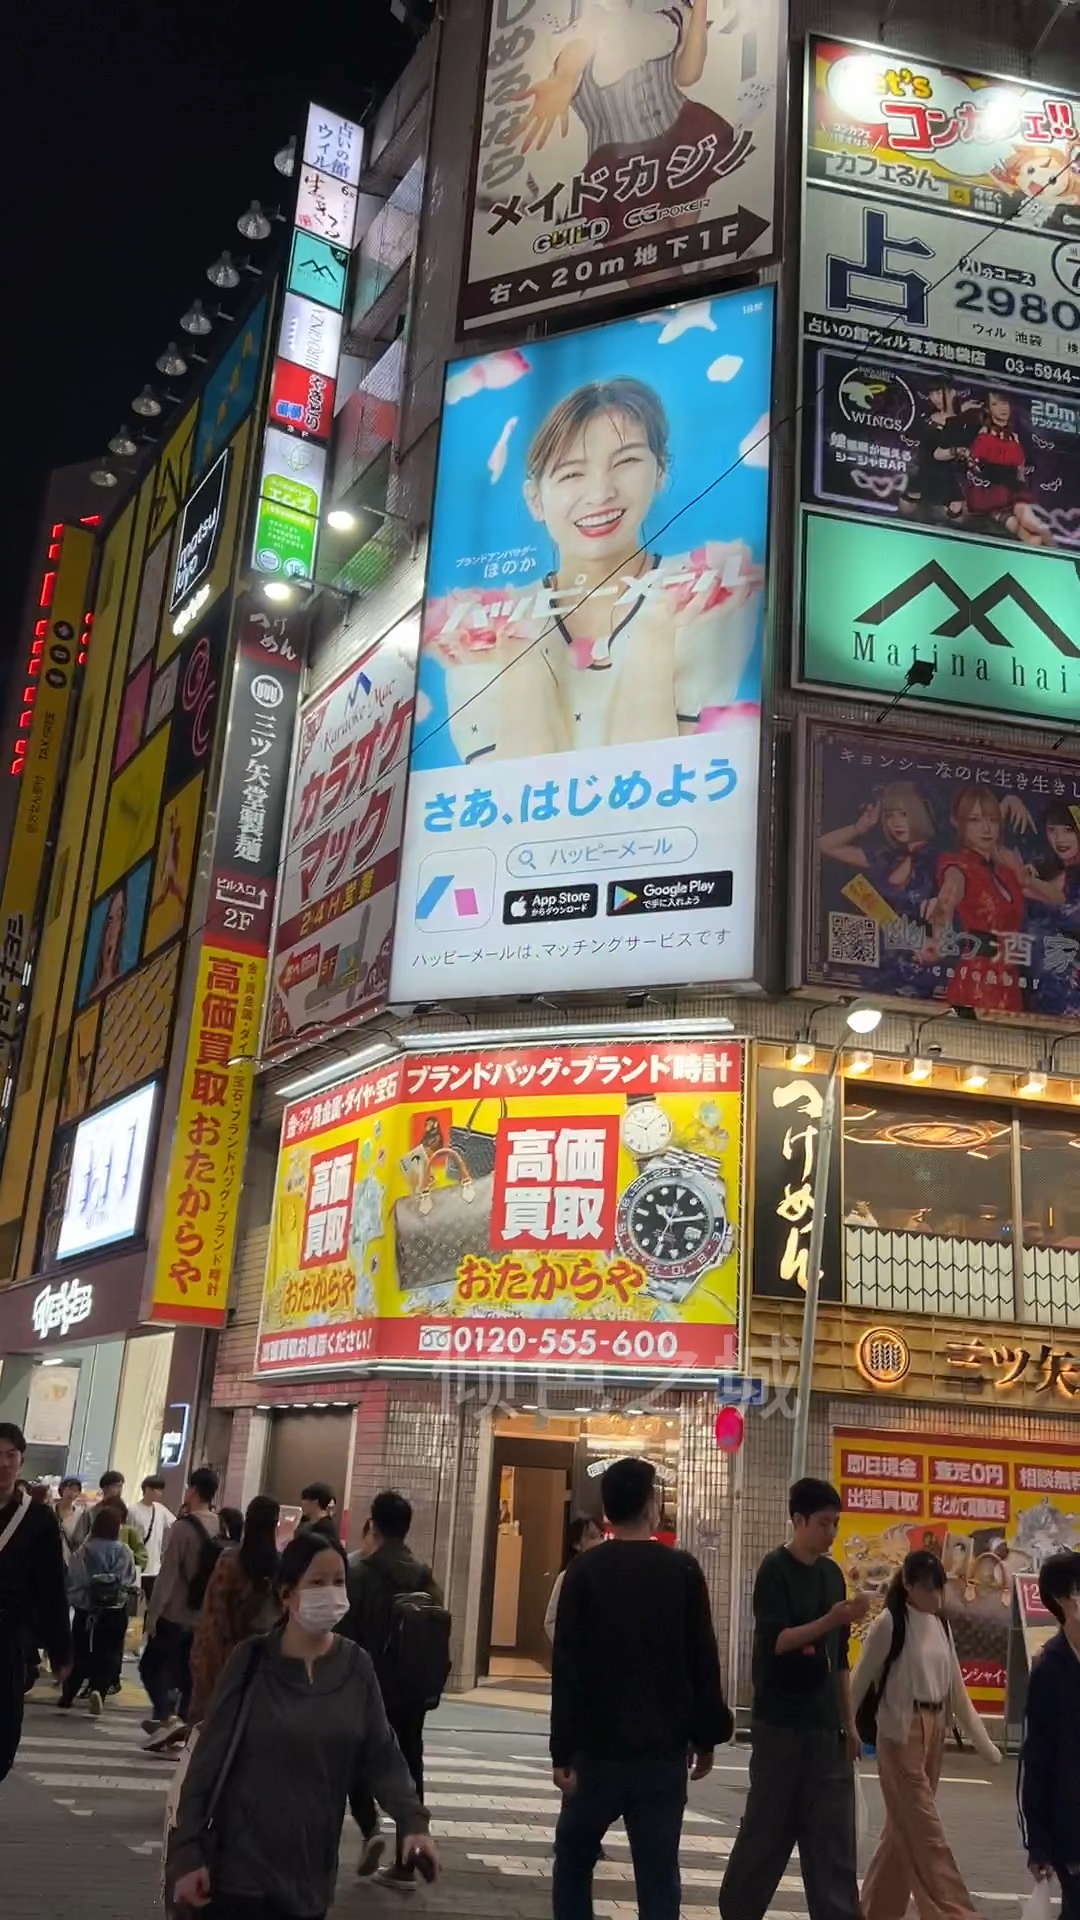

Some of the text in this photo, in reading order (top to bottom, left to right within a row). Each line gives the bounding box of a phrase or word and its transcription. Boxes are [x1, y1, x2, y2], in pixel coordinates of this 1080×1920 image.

[881, 101, 1074, 152] コンカェ!!
[487, 130, 756, 236] メイドカジノ
[532, 218, 610, 254] GUILD
[826, 206, 936, 328] 占
[959, 256, 1036, 287] 20分コース
[954, 279, 1080, 331] 2980
[851, 410, 903, 433] WINGS
[483, 557, 537, 579] ほのか
[441, 553, 763, 636] ハッピーメール
[1012, 655, 1080, 695] hai
[291, 700, 414, 842] カラオケ
[424, 758, 738, 833] さあ、はじめよう
[548, 836, 674, 866] ハッピーメール
[216, 876, 257, 897] ビル入口
[300, 868, 376, 936] 24H営業
[531, 890, 591, 908] App Store
[642, 894, 702, 910] で手に入れよう
[643, 879, 715, 902] Google Play
[223, 909, 255, 931] 2F
[530, 902, 588, 918] からダウンロード
[411, 927, 731, 968] ハッピーメールは、マッチングサービスです
[407, 1052, 733, 1095] ブランドバッグ・ブランド時計
[168, 955, 244, 1295] 高価買取 おたからや
[505, 1127, 608, 1184] 高価
[773, 1078, 827, 1295] つけめん
[500, 1186, 606, 1241] 買取
[286, 1269, 355, 1315] おたからや
[457, 1257, 648, 1303] おたからや
[455, 1327, 678, 1358] 0120-555-600
[846, 1454, 917, 1478] 即日現金
[847, 1488, 919, 1513] 出張買取
